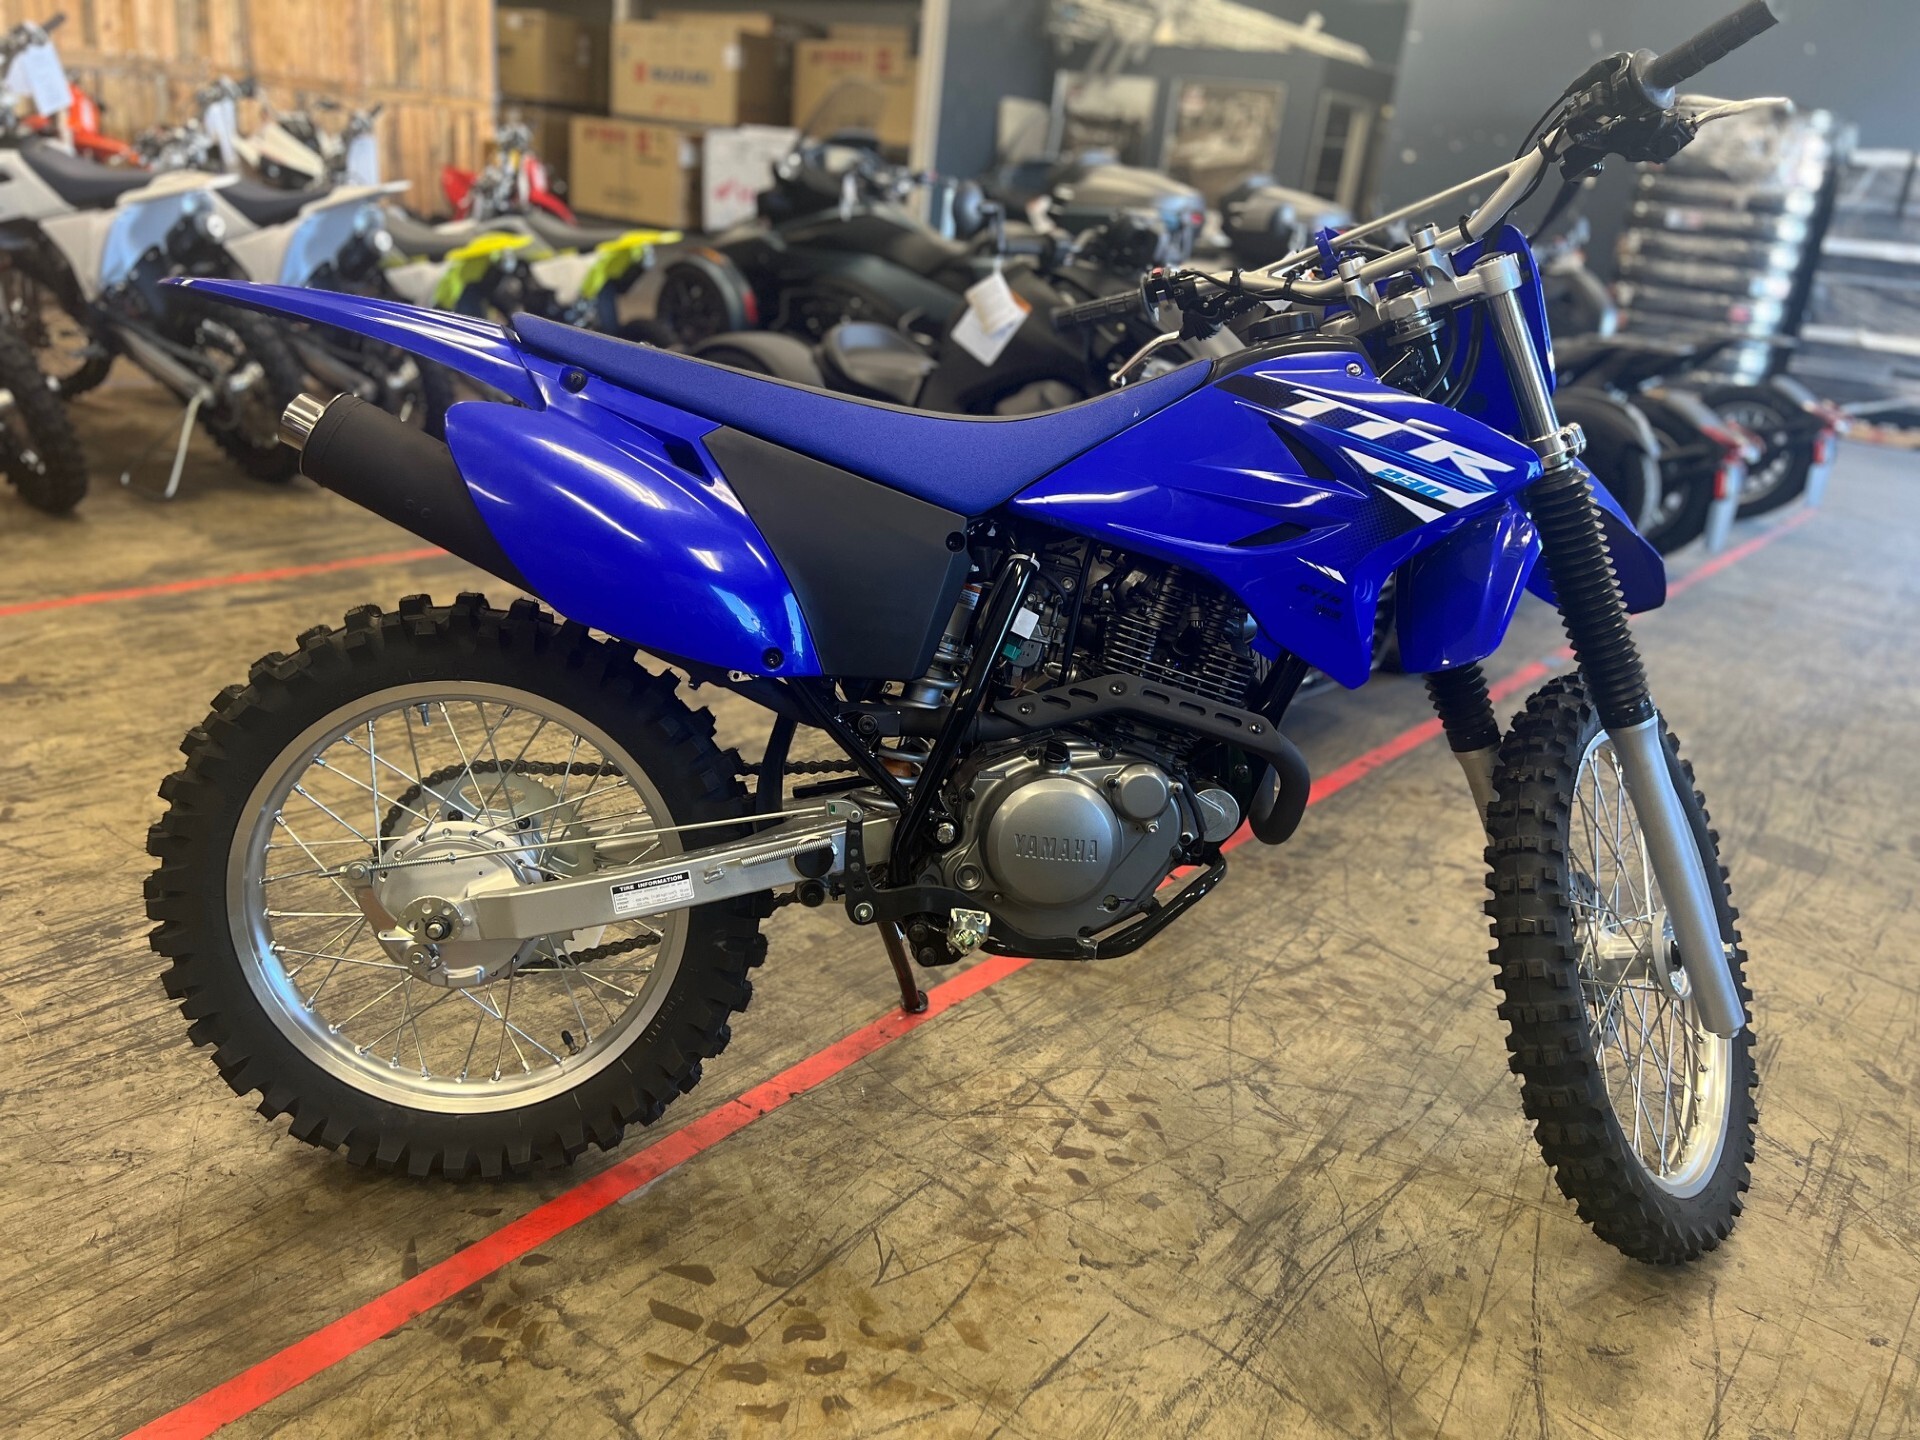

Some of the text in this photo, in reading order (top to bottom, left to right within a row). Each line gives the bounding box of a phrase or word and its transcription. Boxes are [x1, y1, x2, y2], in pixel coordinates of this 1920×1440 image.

[1280, 389, 1516, 486] TTR
[1372, 467, 1449, 499] 230
[1014, 833, 1098, 862] YAMAHA
[618, 884, 635, 893] TIRE
[637, 874, 683, 889] INFORMATION
